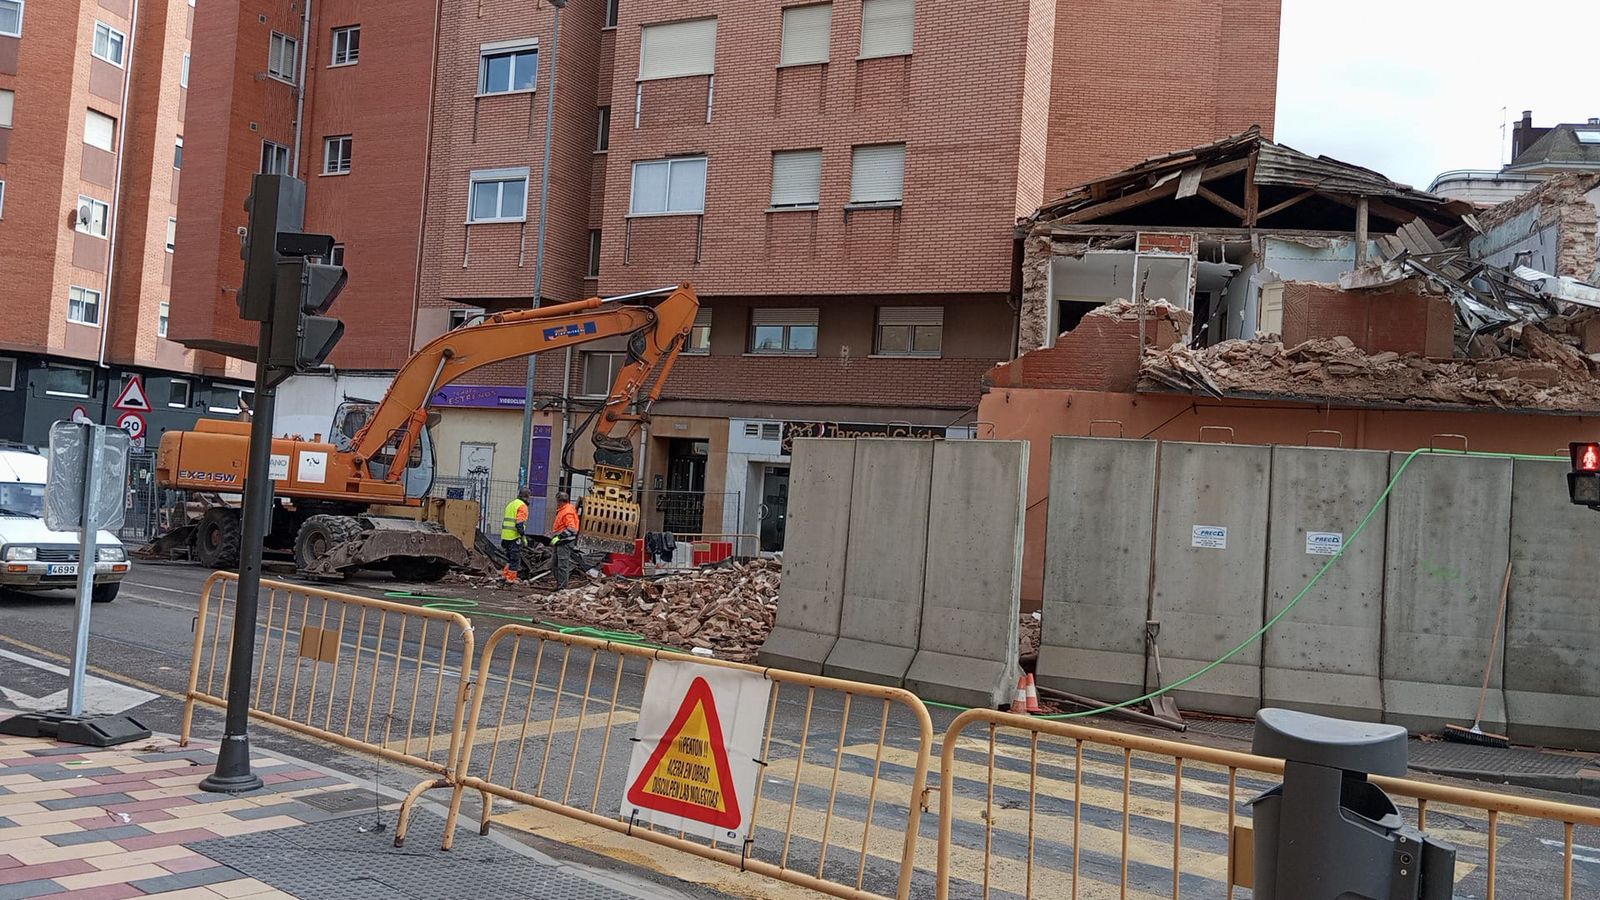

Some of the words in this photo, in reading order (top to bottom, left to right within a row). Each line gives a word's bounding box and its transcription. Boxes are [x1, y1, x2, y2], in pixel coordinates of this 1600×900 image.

[123, 421, 139, 431] 20
[179, 470, 236, 483] EX215W
[52, 566, 75, 574] 4699
[667, 759, 684, 778] ACERA
[683, 762, 693, 779] EN
[691, 764, 710, 784] OBRAS
[652, 776, 680, 798] DISCULPEN
[679, 782, 690, 801] LAS
[689, 785, 719, 808] MOLESTIAS
